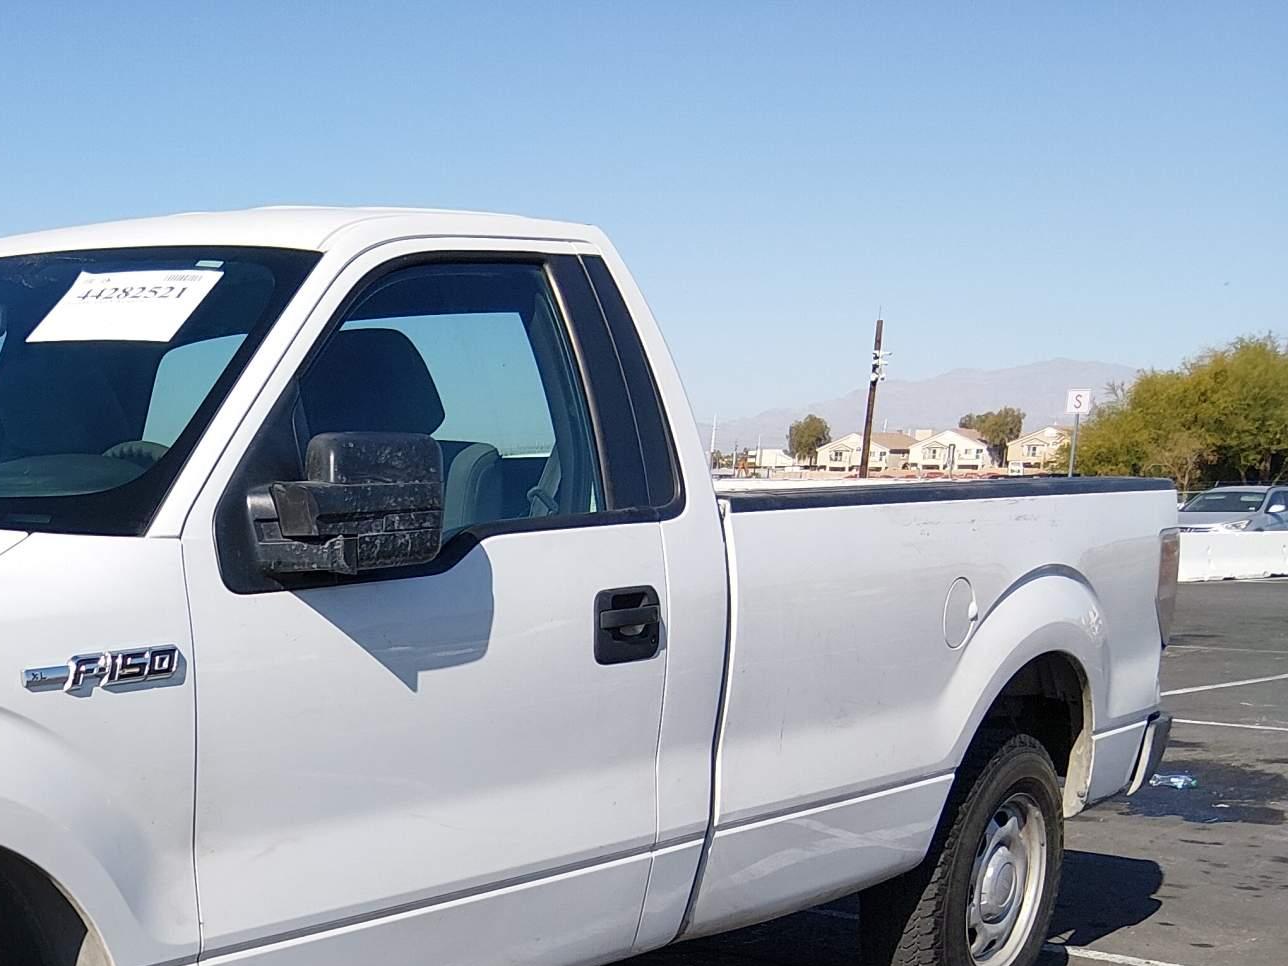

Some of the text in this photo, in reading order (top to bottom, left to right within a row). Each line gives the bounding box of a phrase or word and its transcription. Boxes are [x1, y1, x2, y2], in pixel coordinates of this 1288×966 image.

[77, 286, 188, 299] 44282521
[1075, 394, 1083, 409] S
[32, 672, 47, 681] XL
